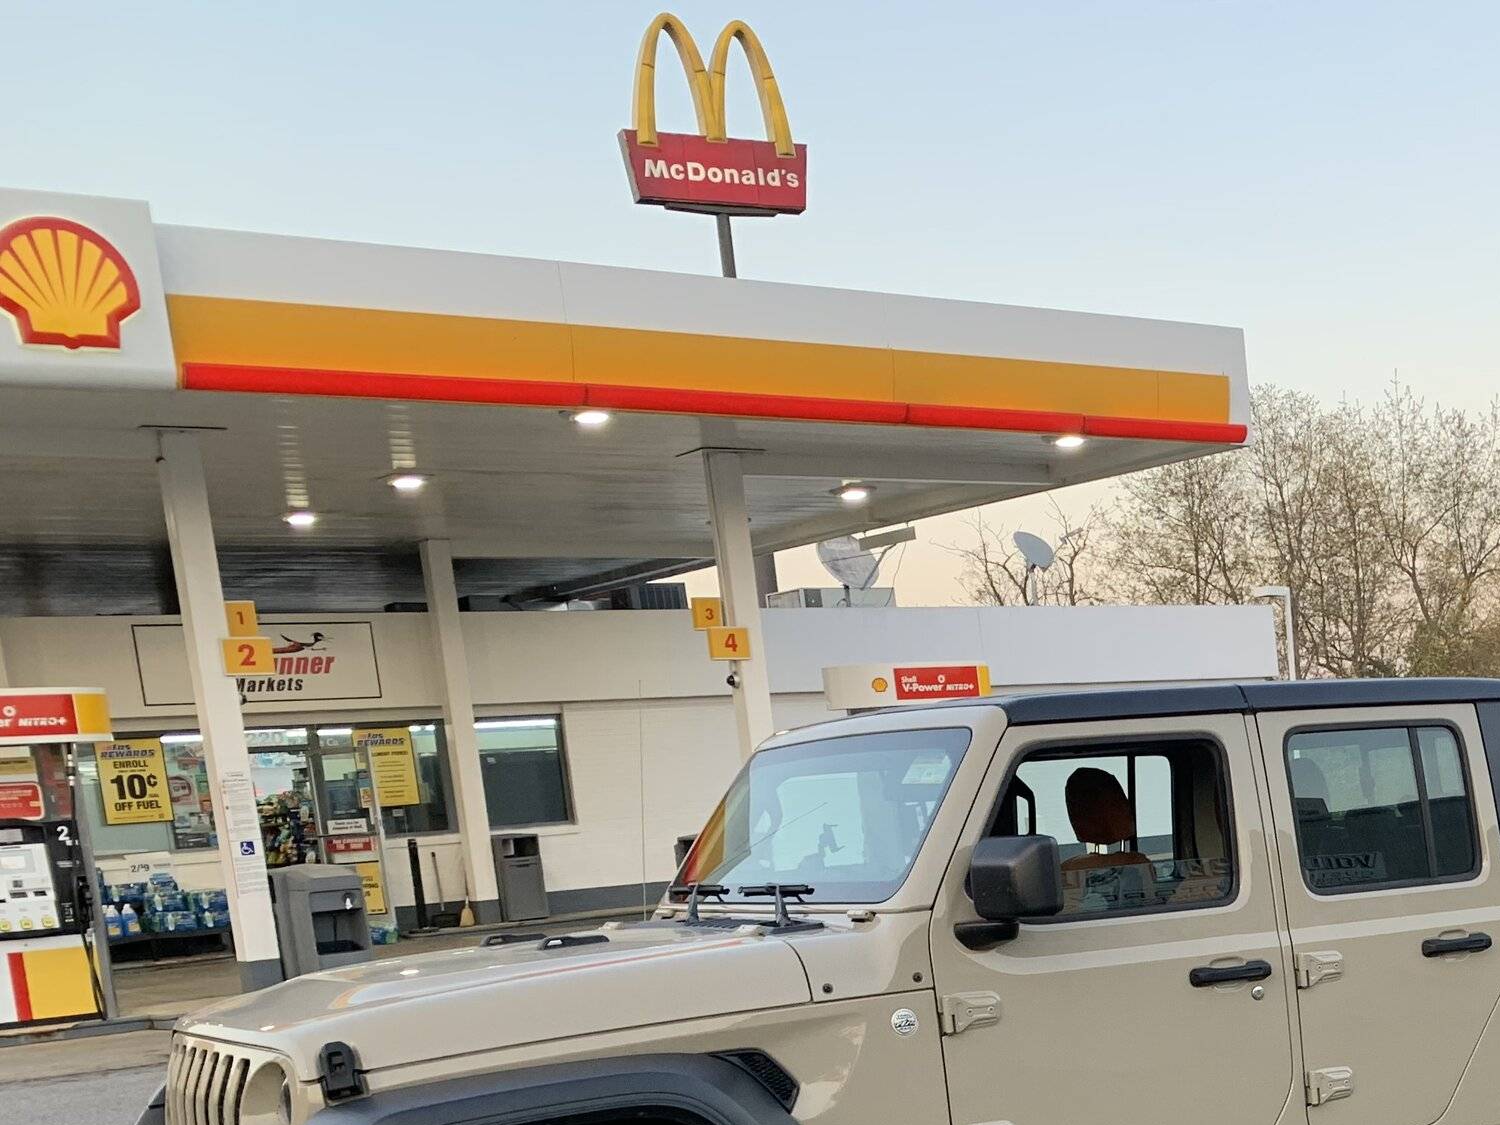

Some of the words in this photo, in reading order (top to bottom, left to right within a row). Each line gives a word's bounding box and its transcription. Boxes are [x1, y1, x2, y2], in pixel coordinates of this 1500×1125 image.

[644, 159, 800, 188] McDonald's
[236, 611, 244, 624] 1
[705, 608, 714, 620] 3
[725, 634, 738, 652] 4
[238, 644, 256, 666] 2
[236, 677, 304, 693] Markets
[902, 683, 944, 693] V-Power
[101, 749, 156, 758] REWARDS
[113, 760, 149, 769] ENROLL
[115, 801, 134, 812] OFF
[137, 799, 162, 810] FUEL
[56, 825, 70, 841] 2
